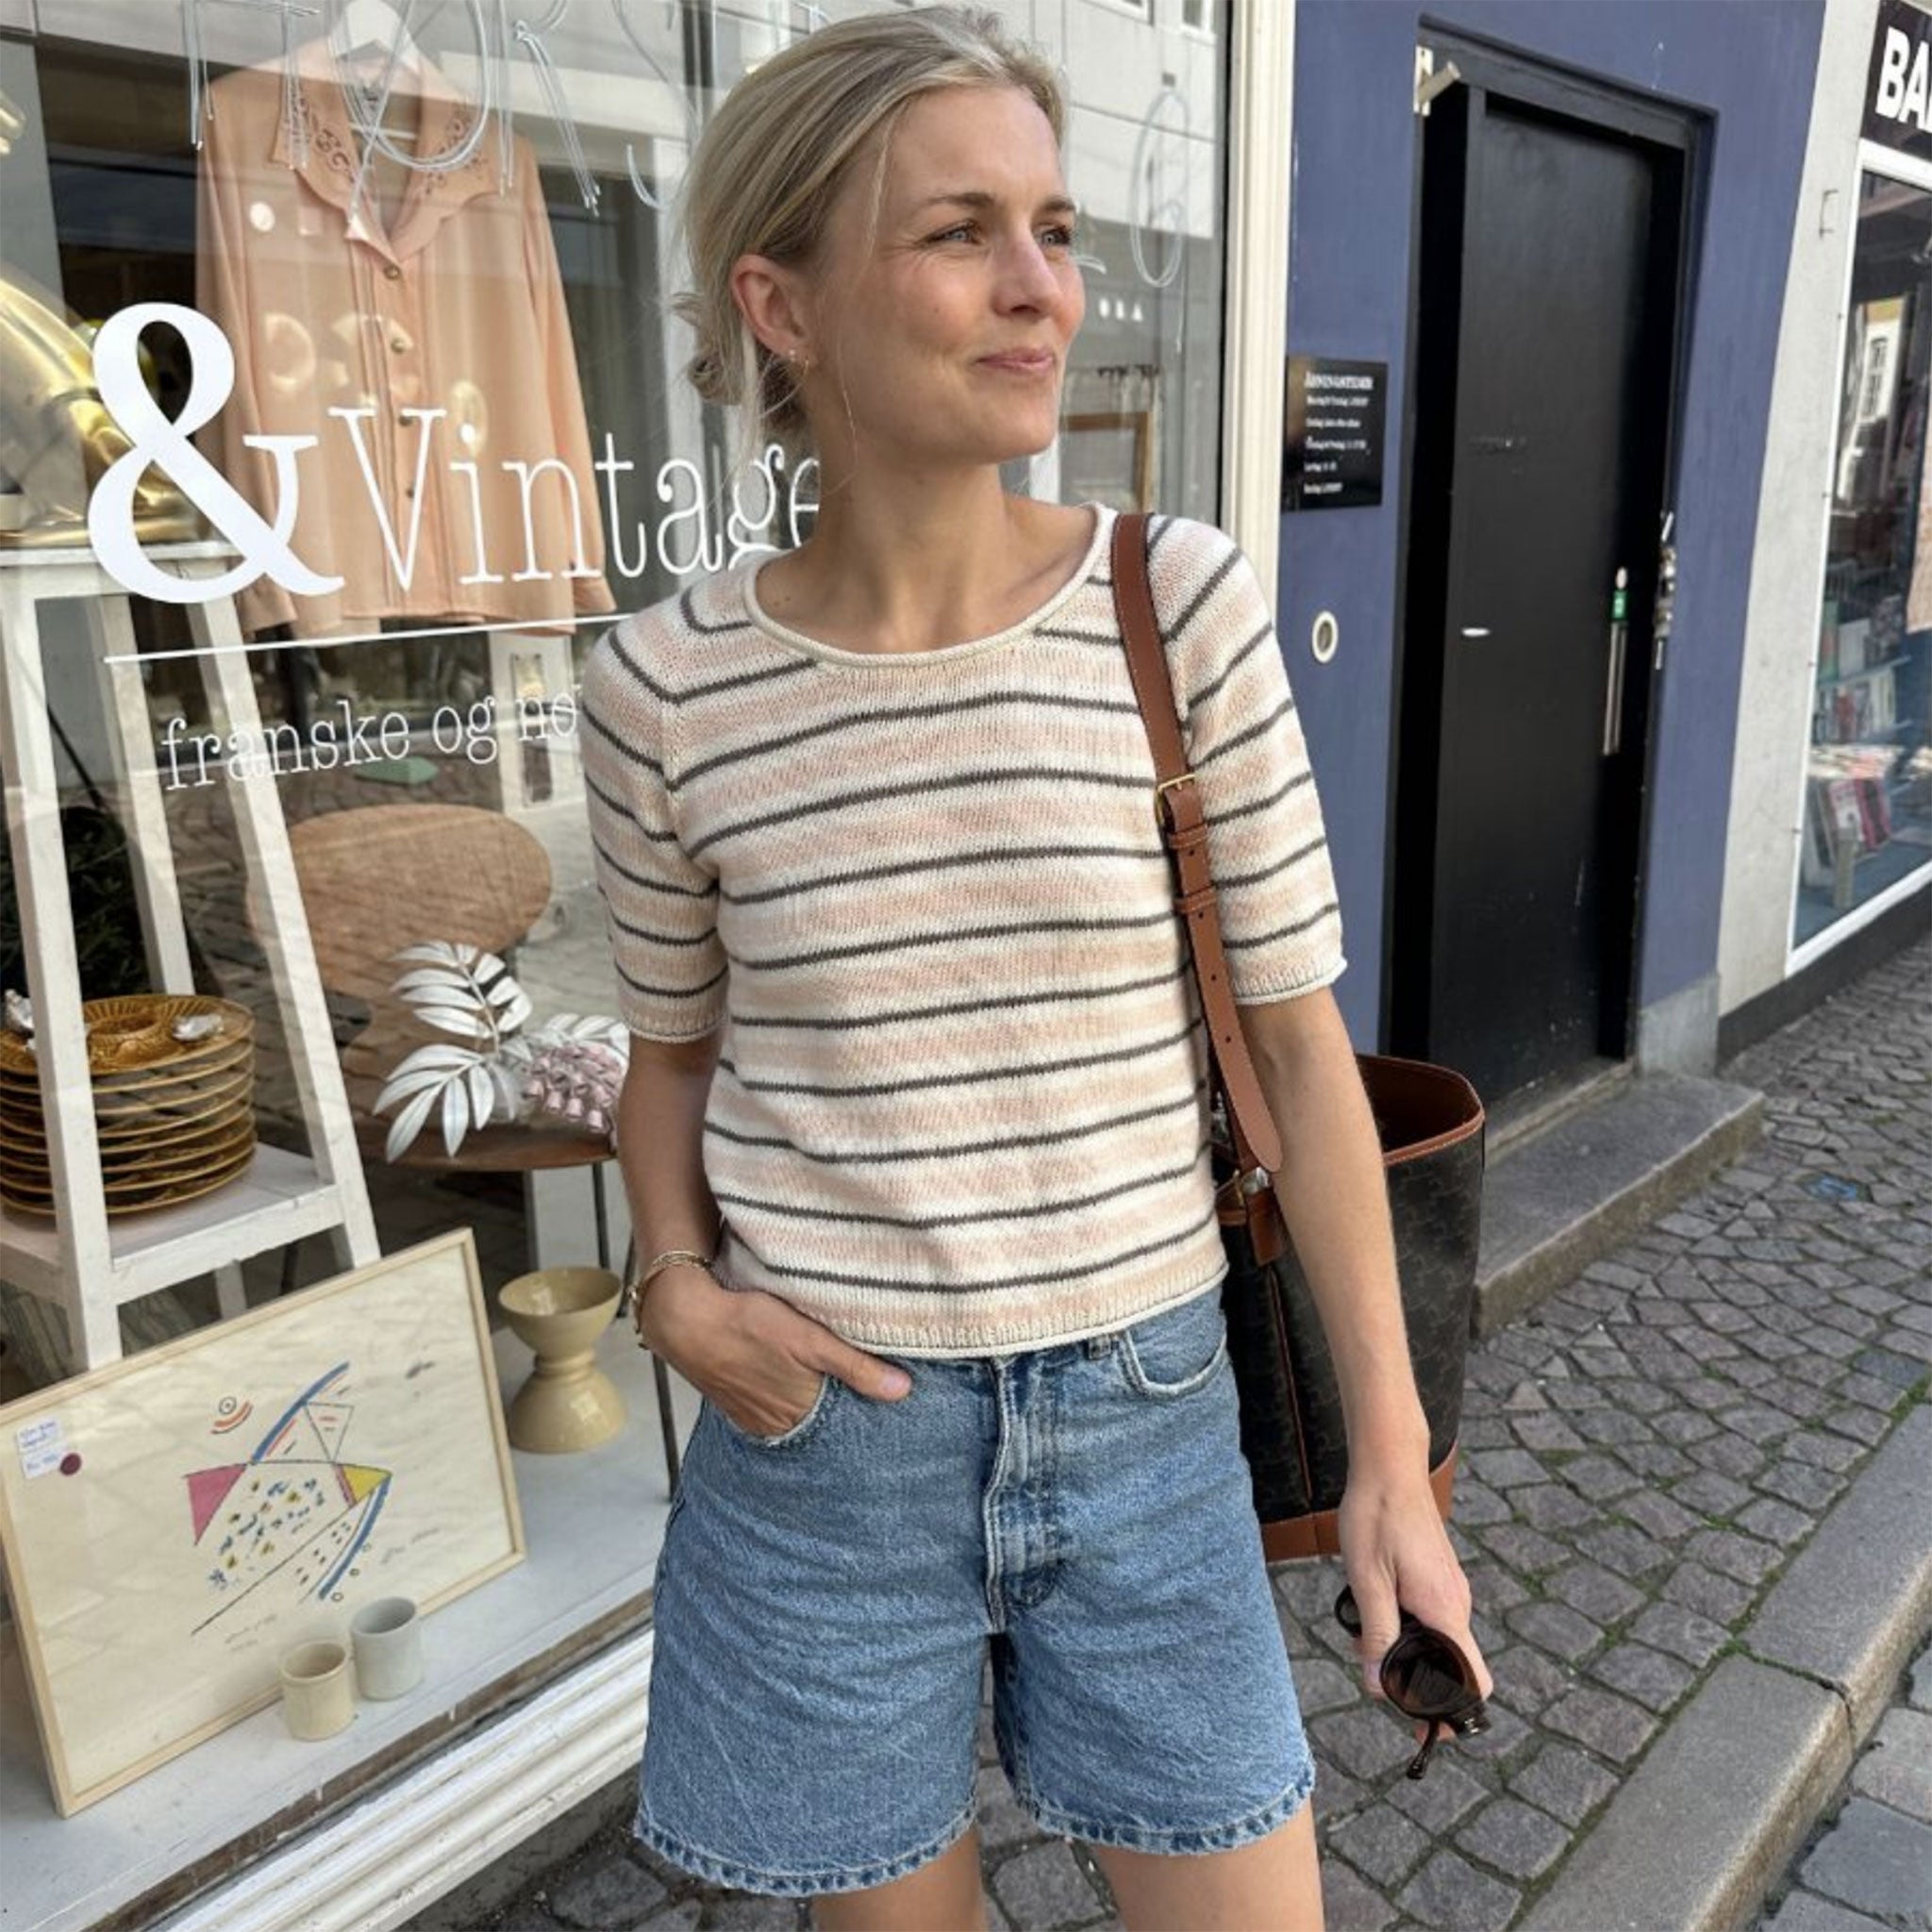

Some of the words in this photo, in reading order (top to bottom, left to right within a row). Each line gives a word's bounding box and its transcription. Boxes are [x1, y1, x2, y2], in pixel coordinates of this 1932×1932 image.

[1875, 25, 1932, 134] BA
[161, 699, 409, 791] franske
[433, 696, 497, 764] og
[516, 684, 582, 741] no
